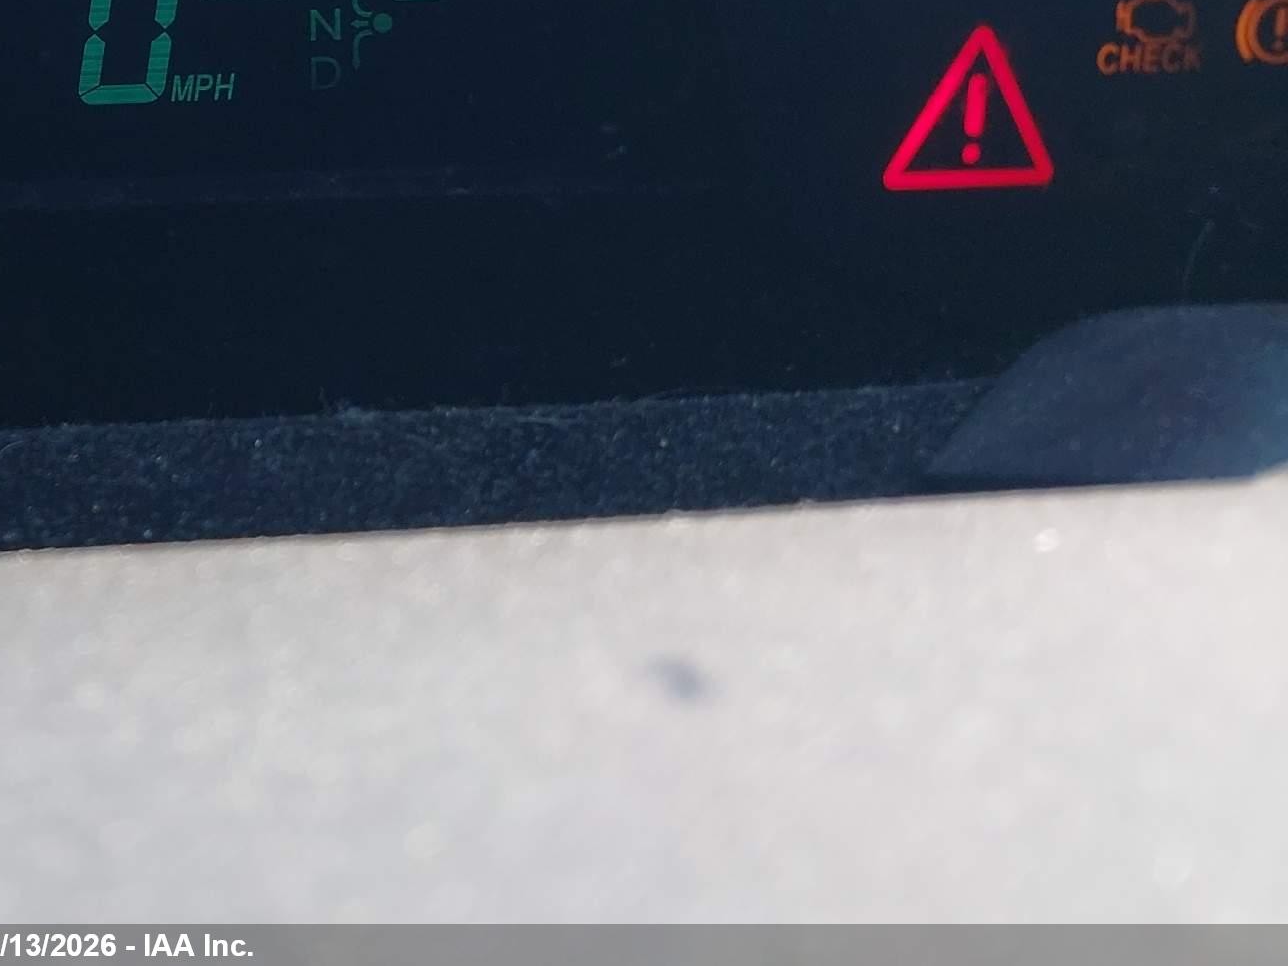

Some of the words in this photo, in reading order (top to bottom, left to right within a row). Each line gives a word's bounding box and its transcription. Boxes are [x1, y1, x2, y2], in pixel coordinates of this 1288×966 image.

[309, 10, 341, 42] N
[309, 57, 341, 91] D
[1096, 42, 1200, 75] CHECK
[170, 73, 236, 103] MPH
